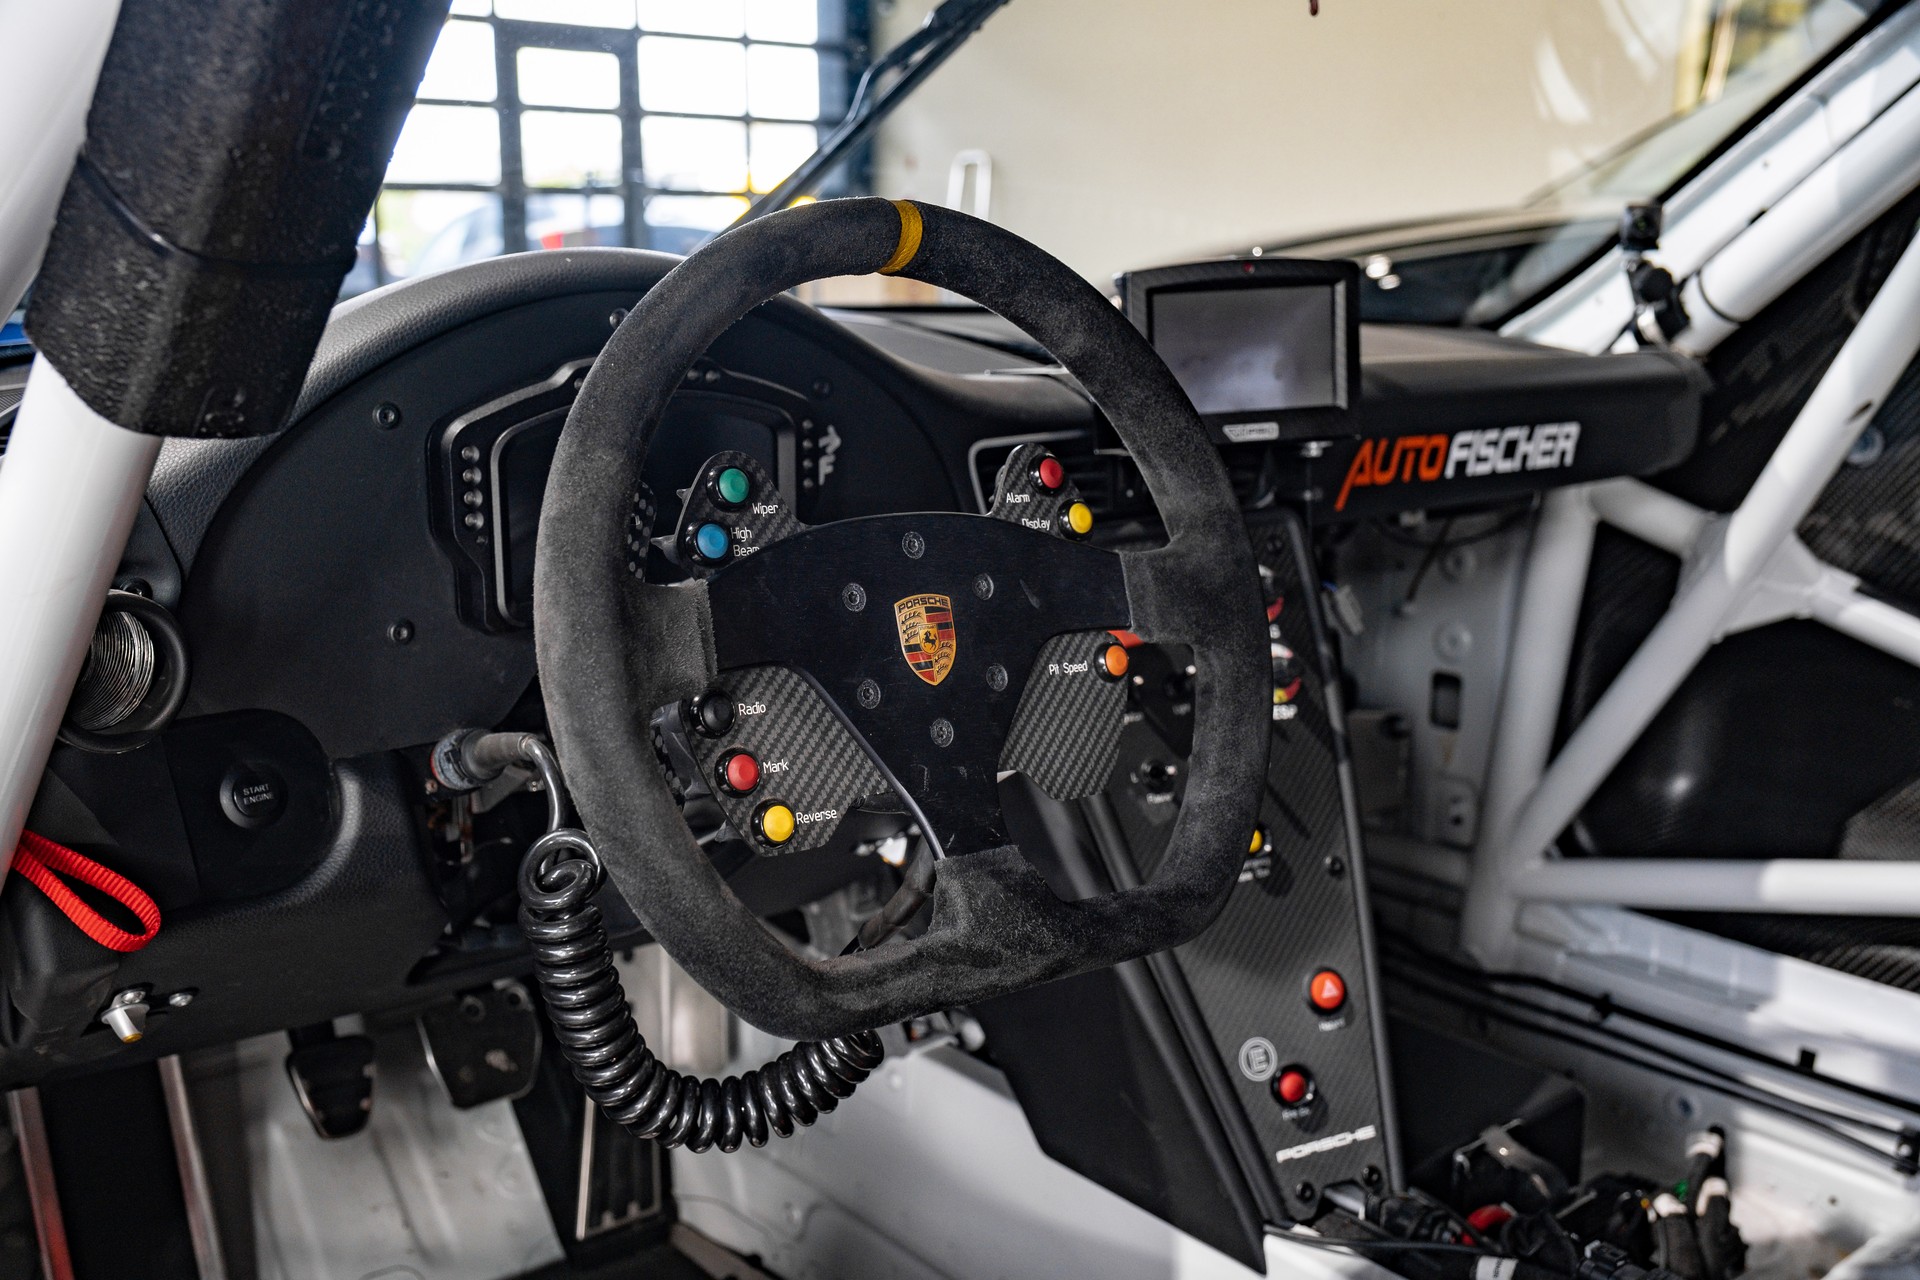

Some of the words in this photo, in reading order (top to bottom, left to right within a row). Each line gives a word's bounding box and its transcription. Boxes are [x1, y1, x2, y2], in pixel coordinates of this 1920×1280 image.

[1006, 492, 1031, 503] Alarm
[752, 502, 779, 517] Wiper
[730, 526, 752, 542] High
[898, 597, 949, 613] PORSCHE
[1048, 663, 1060, 676] Pit
[1063, 660, 1089, 676] Speed
[738, 702, 767, 716] Radio
[762, 758, 790, 774] Mark
[242, 783, 270, 796] START
[243, 792, 274, 806] ENGINE
[795, 808, 838, 824] Reverse
